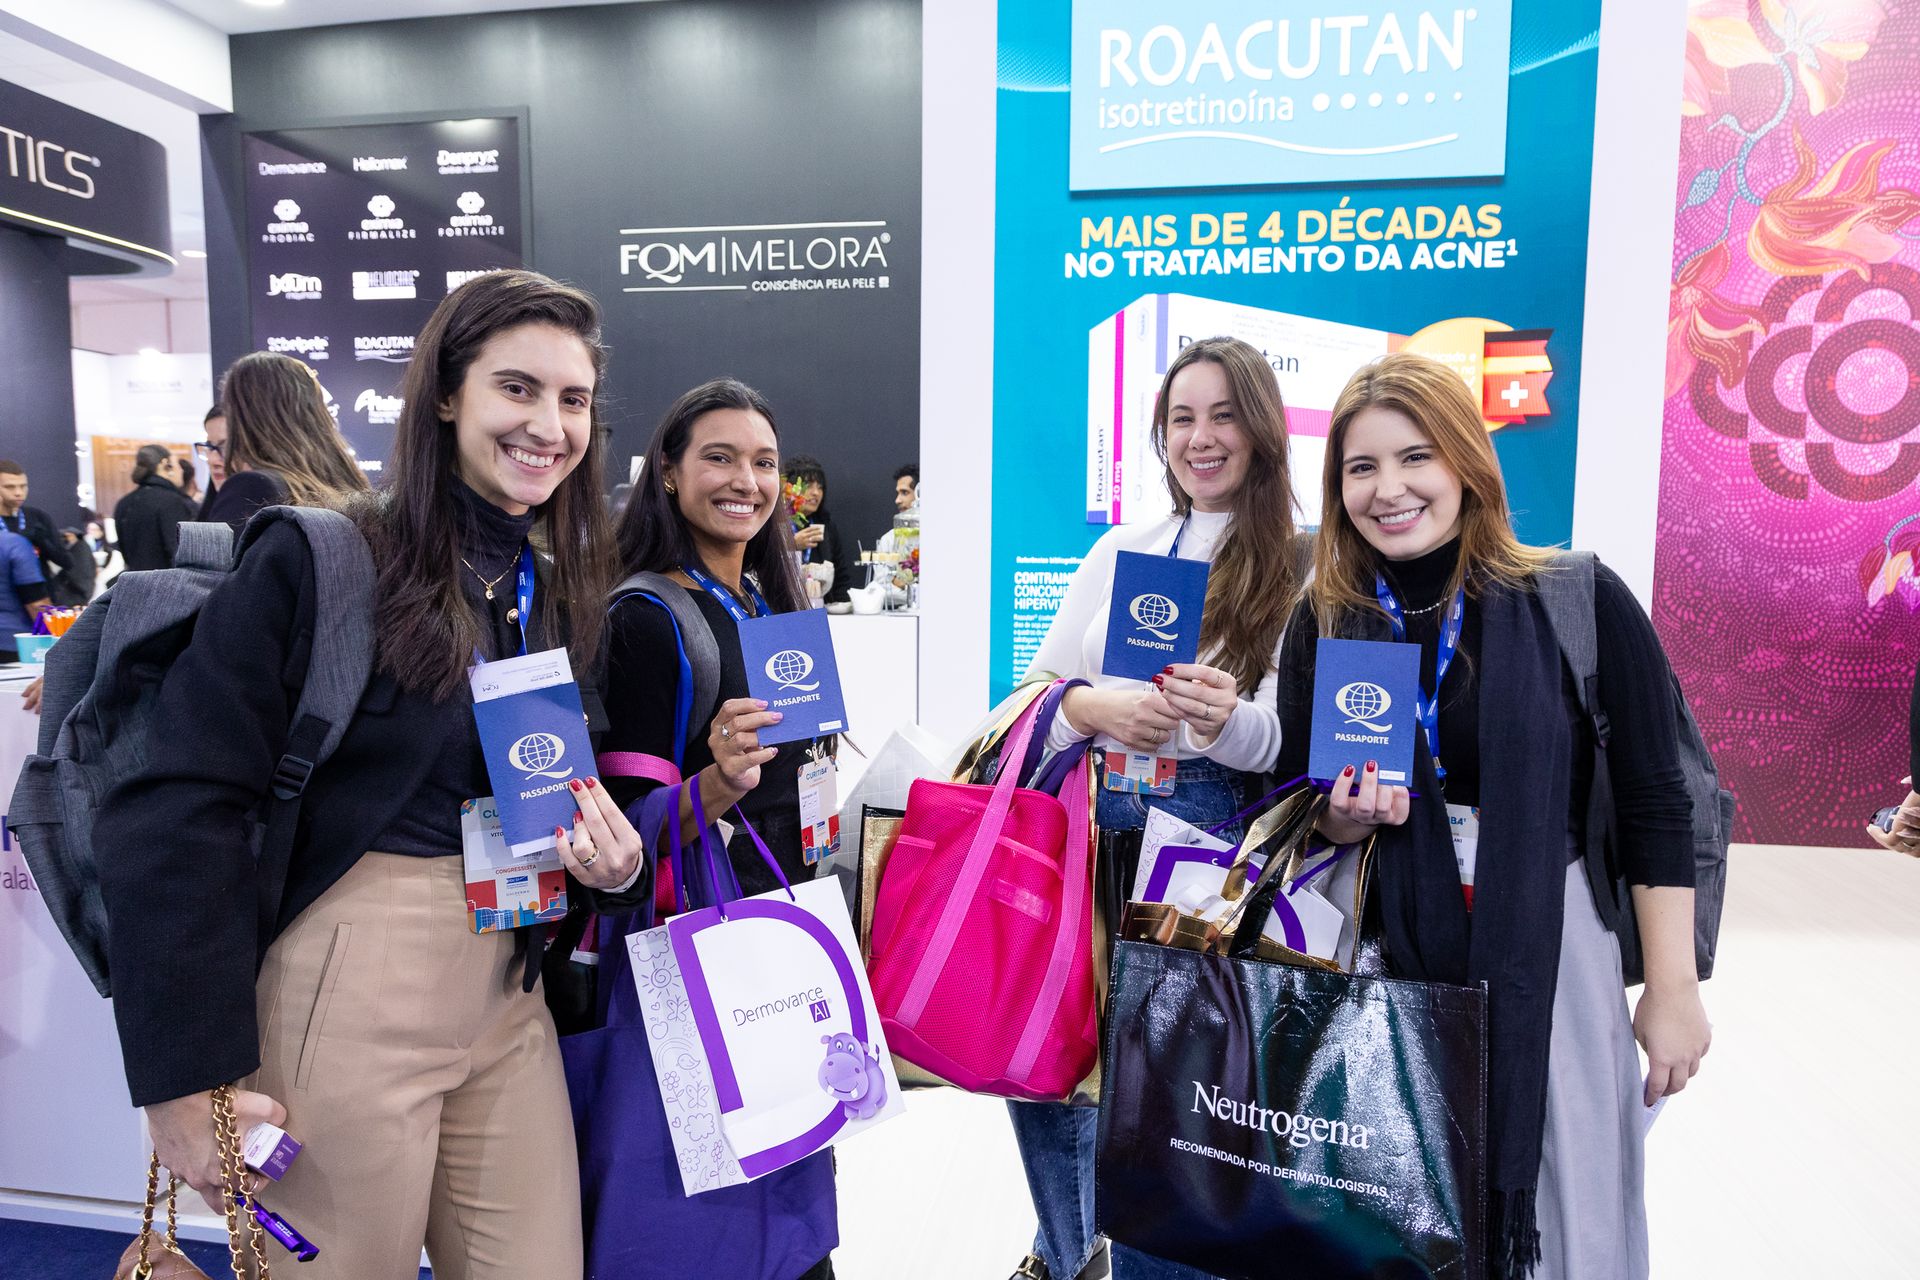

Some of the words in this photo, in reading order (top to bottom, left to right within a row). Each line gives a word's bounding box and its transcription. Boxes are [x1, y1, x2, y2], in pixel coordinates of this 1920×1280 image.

[1099, 9, 1468, 88] ROACUTAN
[1099, 90, 1294, 129] isotretinoína
[1081, 214, 1178, 249] MAIS
[1190, 212, 1248, 246] DE
[1258, 211, 1284, 244] 4
[1297, 196, 1502, 243] DÉCADAS
[620, 243, 716, 284] FQM
[732, 236, 888, 272] MELORA
[1064, 251, 1115, 278] NO
[1122, 244, 1345, 276] TRATAMENTO
[1354, 243, 1402, 272] DA
[752, 277, 823, 292] CONSCIÊNCIA
[826, 279, 850, 290] PELA
[853, 278, 875, 289] PELE
[1113, 486, 1121, 502] 20
[1014, 598, 1060, 610] HIPERVI
[1127, 637, 1175, 652] PASSAPORTE
[773, 693, 821, 708] PASSAPORTE
[1335, 733, 1389, 745] PASSAPORTE
[520, 782, 570, 800] PASSAPORT
[495, 864, 537, 875] CONGRESSISTA
[732, 985, 825, 1027] Dermovance
[812, 1001, 829, 1022] AI
[1190, 1080, 1370, 1149] Neutrogena
[1170, 1137, 1246, 1168] RECOMENDADA
[1248, 1160, 1271, 1175] POR
